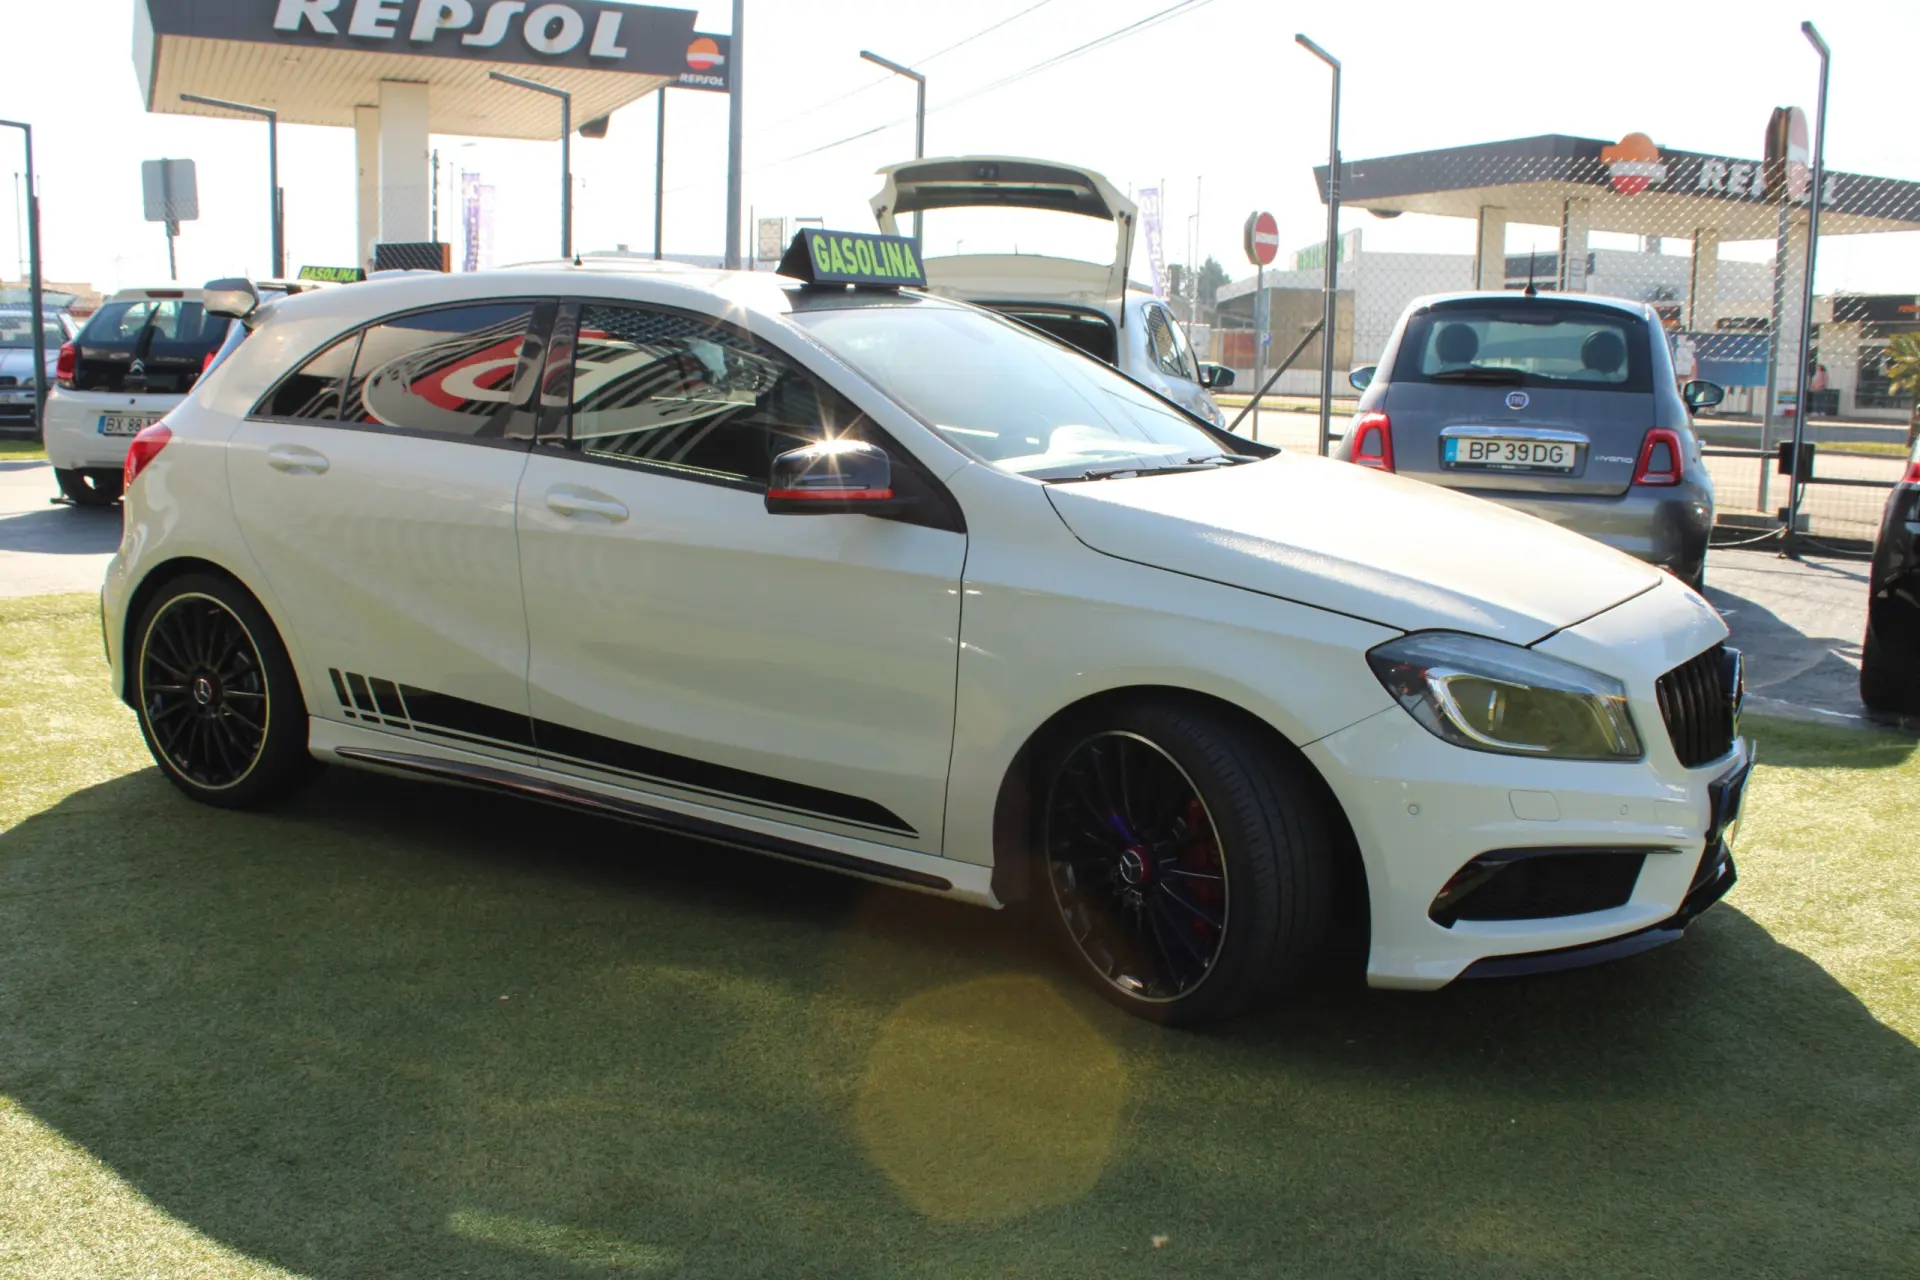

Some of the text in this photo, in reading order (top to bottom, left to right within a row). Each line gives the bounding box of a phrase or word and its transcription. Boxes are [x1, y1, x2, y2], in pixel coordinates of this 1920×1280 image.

[273, 0, 628, 58] REPSOL
[679, 73, 725, 86] REPSOL
[812, 235, 921, 278] GASOLINA
[301, 267, 358, 282] GASOLINA
[106, 417, 123, 432] BX
[128, 418, 142, 432] 88
[1469, 441, 1564, 464] BP 39 DG
